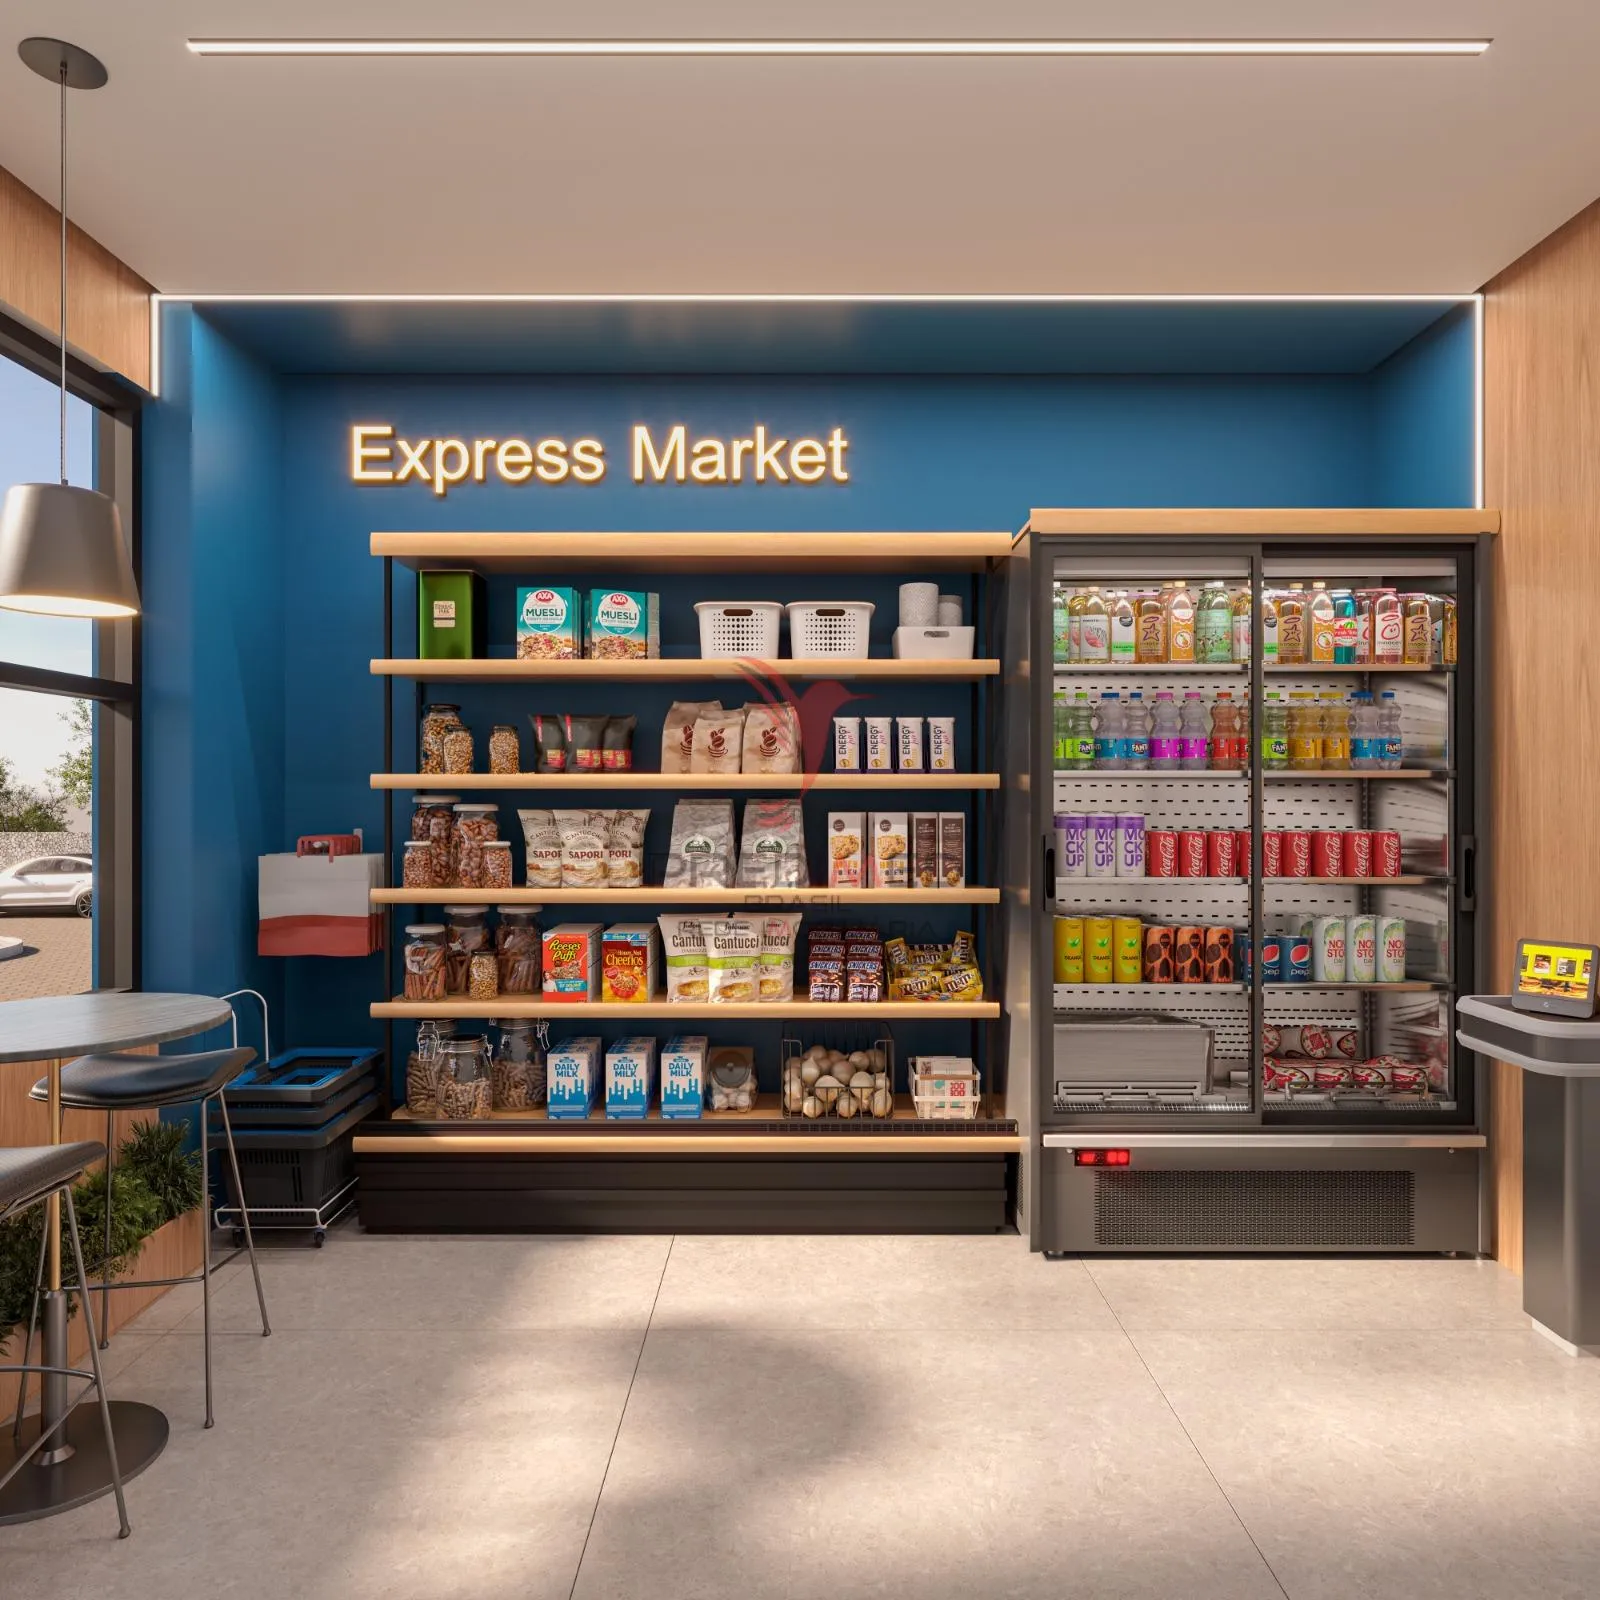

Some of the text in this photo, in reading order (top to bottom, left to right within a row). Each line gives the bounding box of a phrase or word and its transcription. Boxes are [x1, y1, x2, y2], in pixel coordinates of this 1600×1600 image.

[351, 425, 849, 497] Express Market
[537, 591, 554, 600] AXA
[612, 595, 627, 604] AXA
[525, 608, 564, 617] MUESLI
[600, 610, 637, 621] MUESLI
[838, 725, 846, 755] ENERGY
[870, 725, 878, 755] ENERGY
[902, 725, 910, 755] ENERGY
[934, 725, 942, 755] ENERGY
[1065, 840, 1085, 854] CK
[1094, 840, 1114, 854] CK
[1124, 840, 1143, 854] CK
[533, 850, 562, 858] SAPOR
[568, 850, 603, 859] SAPORI
[609, 850, 632, 858] PORI
[1065, 854, 1085, 867] UP
[1094, 854, 1114, 867] UP
[1124, 854, 1143, 867] UP
[672, 935, 706, 948] Cantu
[714, 935, 759, 950] Cantucci
[761, 934, 790, 947] tucci
[552, 950, 577, 962] Puffs
[606, 953, 644, 966] Cheerios
[809, 961, 840, 970] SNICKERS
[847, 961, 879, 970] SNICKERS
[554, 1063, 580, 1071] DAILY
[613, 1063, 638, 1071] DAILY
[668, 1062, 694, 1070] DAILY
[556, 1070, 578, 1078] MILK
[614, 1070, 637, 1078] MILK
[670, 1069, 692, 1077] MILK
